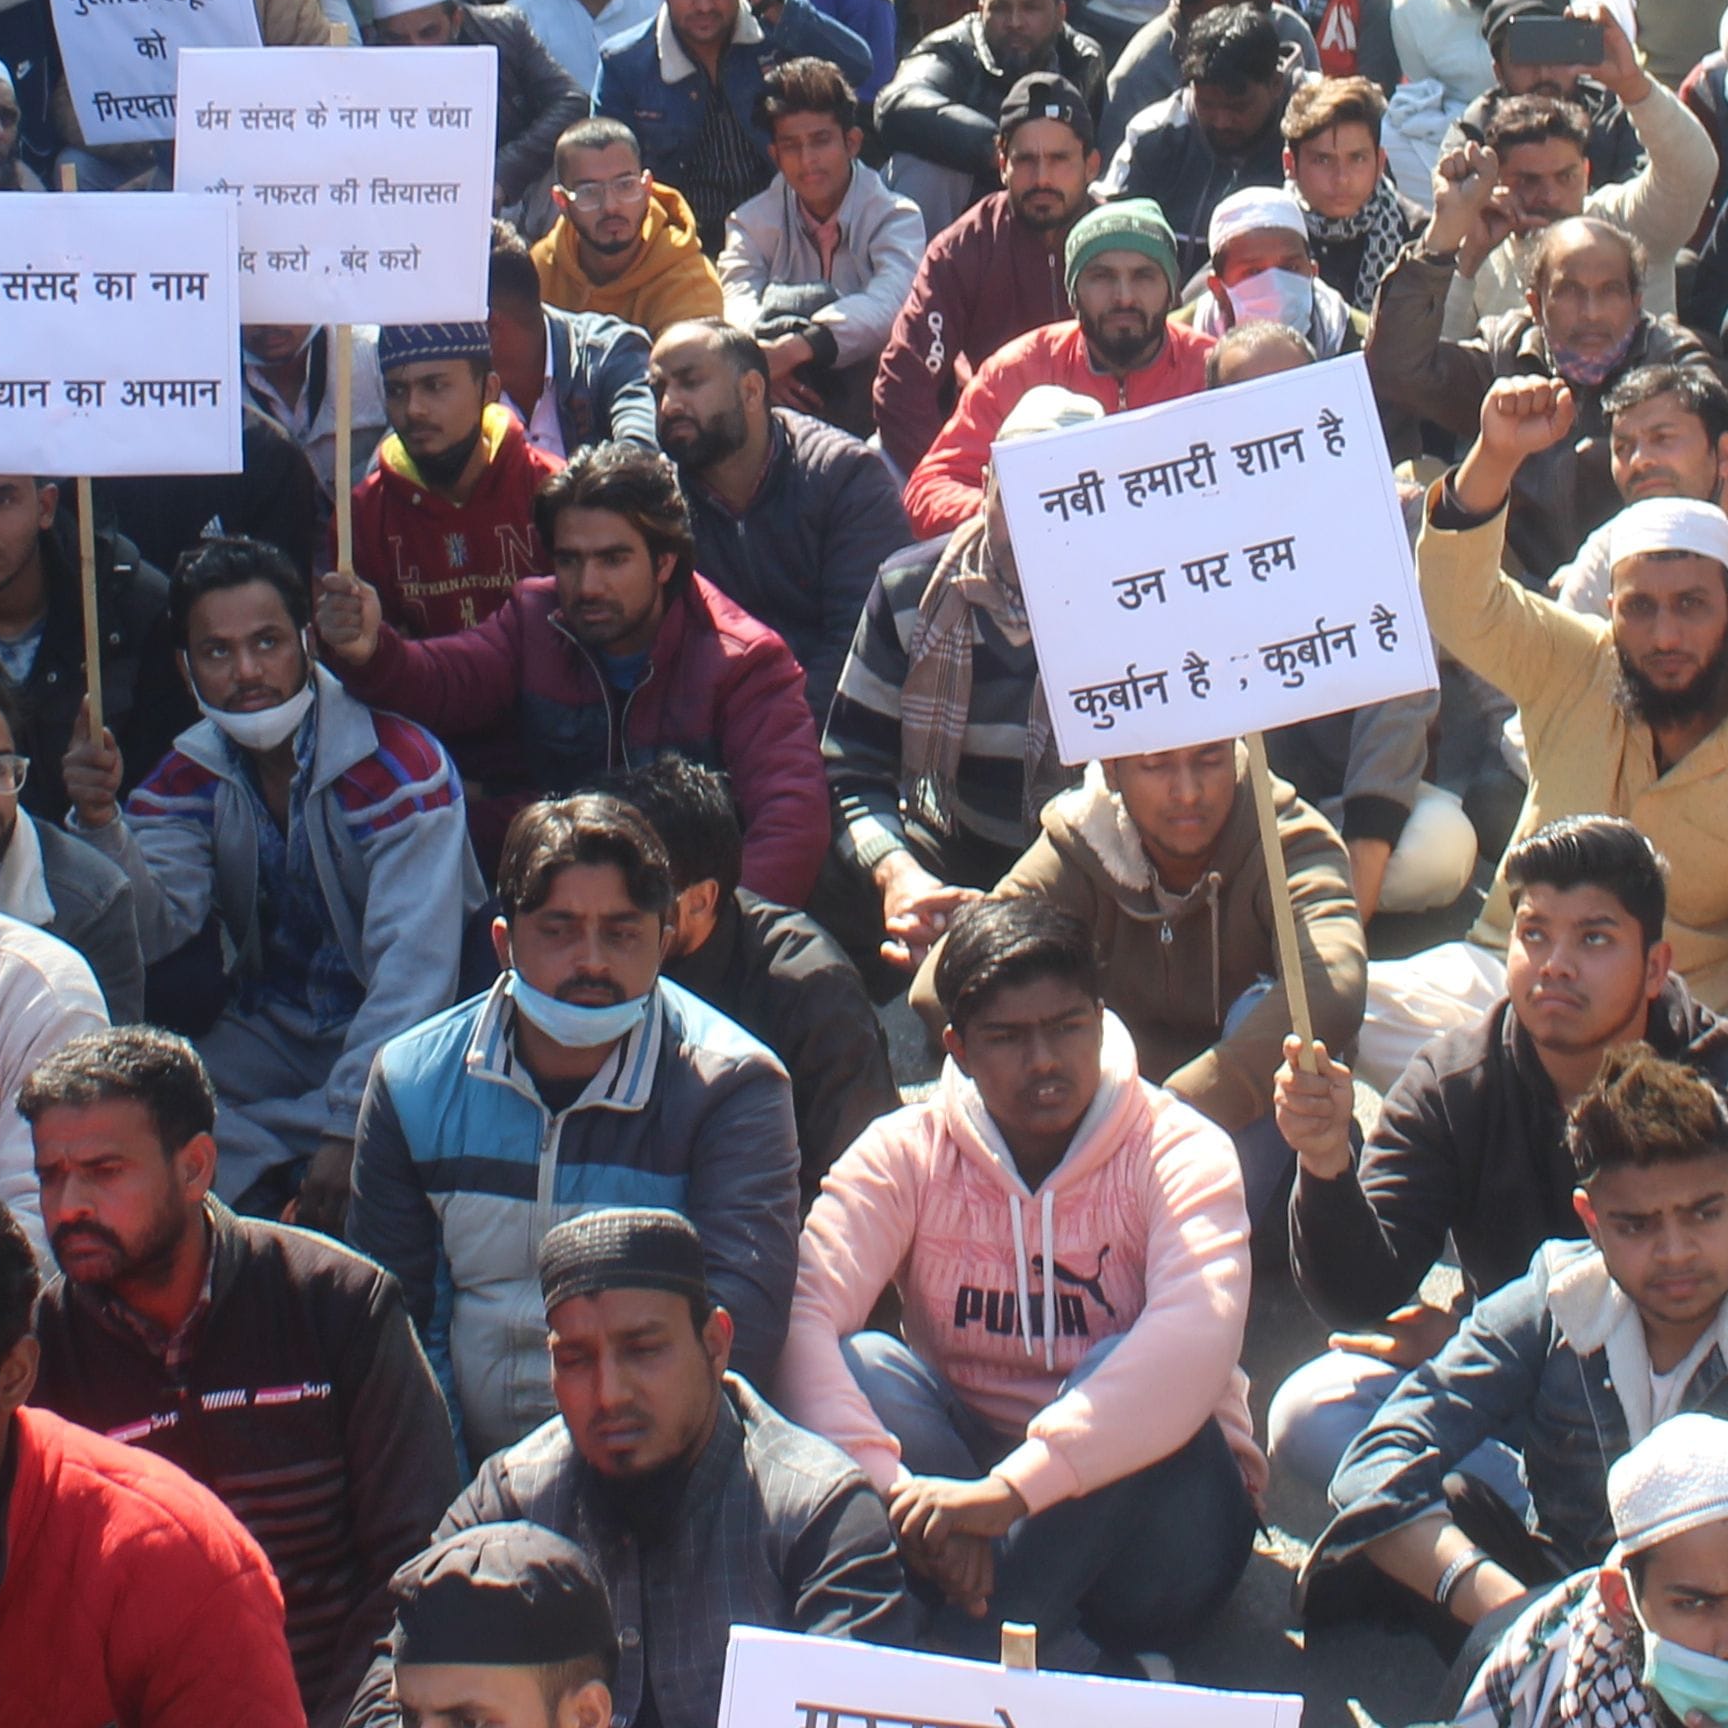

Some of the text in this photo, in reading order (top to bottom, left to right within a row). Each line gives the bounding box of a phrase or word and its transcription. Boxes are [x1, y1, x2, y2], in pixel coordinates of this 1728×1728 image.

[133, 28, 168, 61] को
[92, 90, 177, 123] गिरफ्ता
[240, 102, 297, 132] संसद
[306, 101, 329, 129] के
[338, 106, 381, 130] नाम
[388, 106, 419, 130] पर
[254, 183, 320, 206] नफरत
[328, 177, 361, 205] की
[370, 177, 461, 205] सियासत
[267, 244, 311, 273] करो
[339, 244, 370, 273] बंद
[378, 242, 422, 272] करो
[93, 271, 138, 302] का
[148, 271, 210, 302] नाम
[63, 379, 107, 408] का
[120, 379, 223, 408] अपमान
[1038, 407, 1348, 524] नबी हमारी शान है
[402, 573, 518, 598] INTERNATIONA
[1111, 535, 1297, 612] उन पर हम
[1068, 663, 1170, 730] कुर्बान
[1181, 650, 1212, 700] है
[1258, 616, 1360, 689] कुर्बान
[1369, 603, 1400, 653] है
[302, 1379, 332, 1400] Sup
